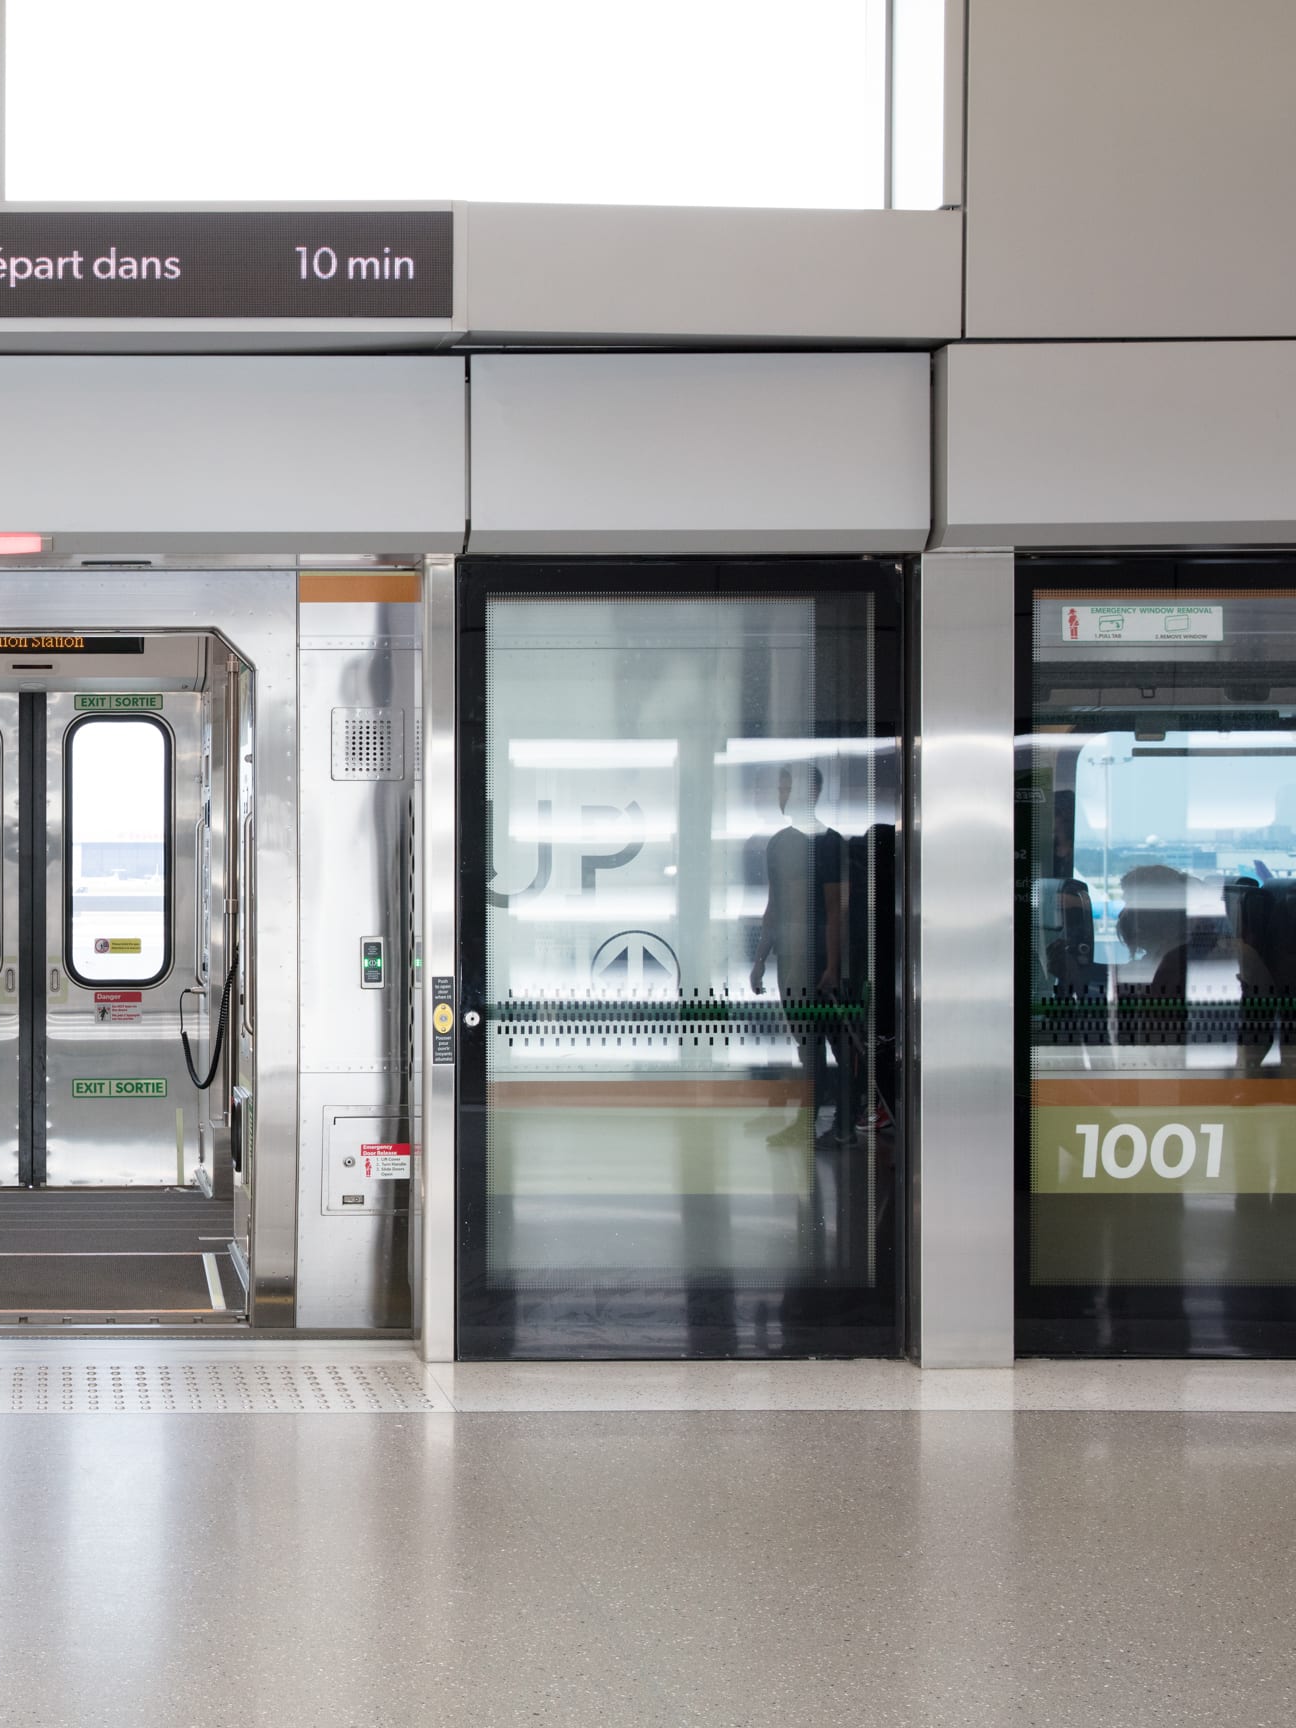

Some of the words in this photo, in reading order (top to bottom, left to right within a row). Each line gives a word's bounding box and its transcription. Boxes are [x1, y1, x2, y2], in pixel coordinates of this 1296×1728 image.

[92, 246, 181, 281] dans
[295, 246, 338, 281] 10
[348, 246, 414, 281] min
[1090, 607, 1136, 615] EMERGENCY
[1139, 607, 1174, 615] WINDOW
[1177, 607, 1213, 615] REMOVAL
[80, 697, 106, 707] EXIT
[115, 697, 156, 707] SORTIE
[96, 993, 121, 1001] Danger
[76, 1082, 104, 1093] EXIT
[115, 1082, 163, 1093] SORTIE
[1075, 1123, 1224, 1179] 1001
